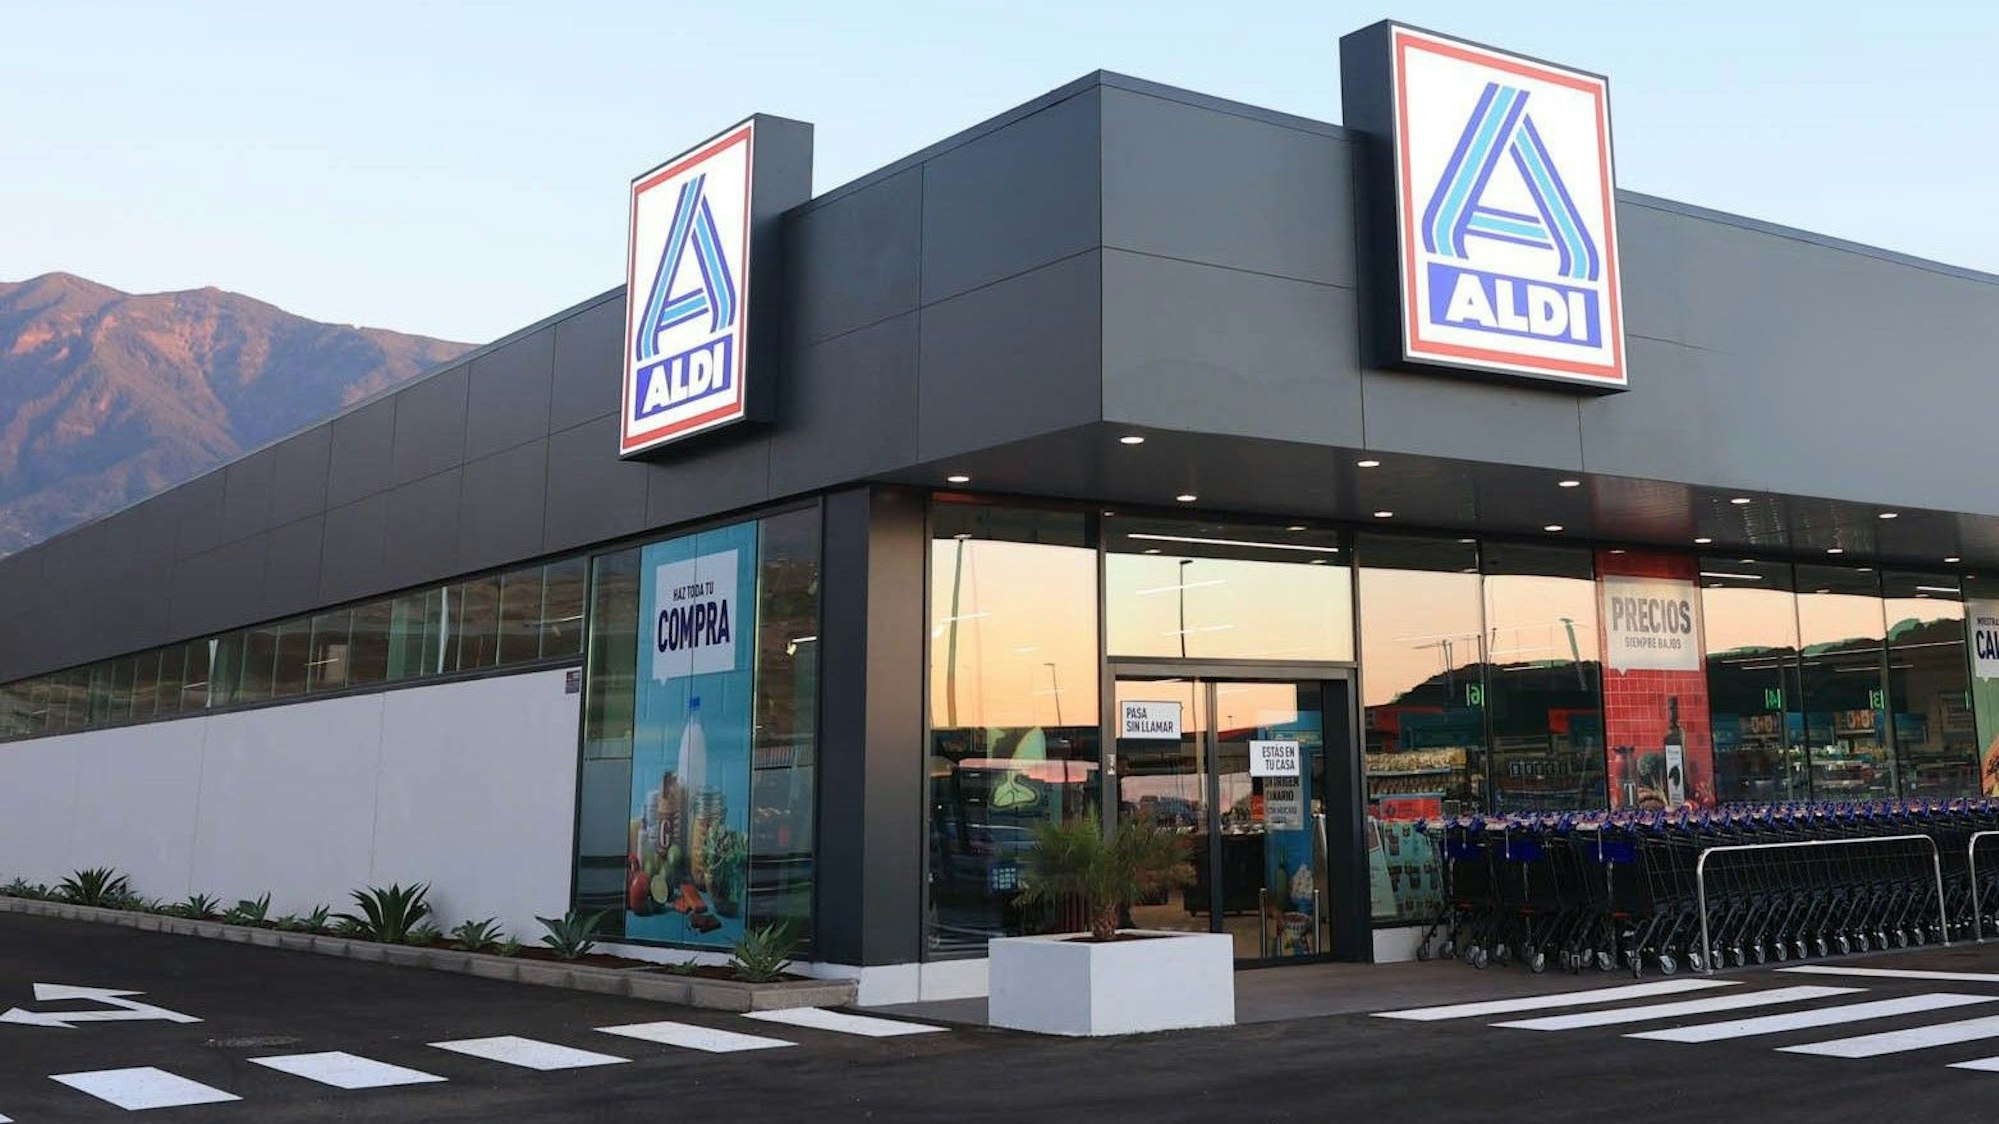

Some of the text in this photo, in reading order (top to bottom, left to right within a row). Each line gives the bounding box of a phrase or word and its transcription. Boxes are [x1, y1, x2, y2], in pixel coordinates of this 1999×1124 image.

[1445, 272, 1589, 342] ALDI
[642, 341, 725, 415] ALDI
[673, 581, 714, 601] HAZ TODA TU
[1612, 596, 1691, 635] PRECIOS
[658, 599, 730, 653] COMPRA
[1625, 636, 1682, 650] SIEMPRE BAJOS
[1126, 706, 1148, 719] PASA
[1126, 720, 1174, 733] SIN LLAMAR
[1285, 745, 1295, 758] EN
[1265, 759, 1295, 771] TU CASA
